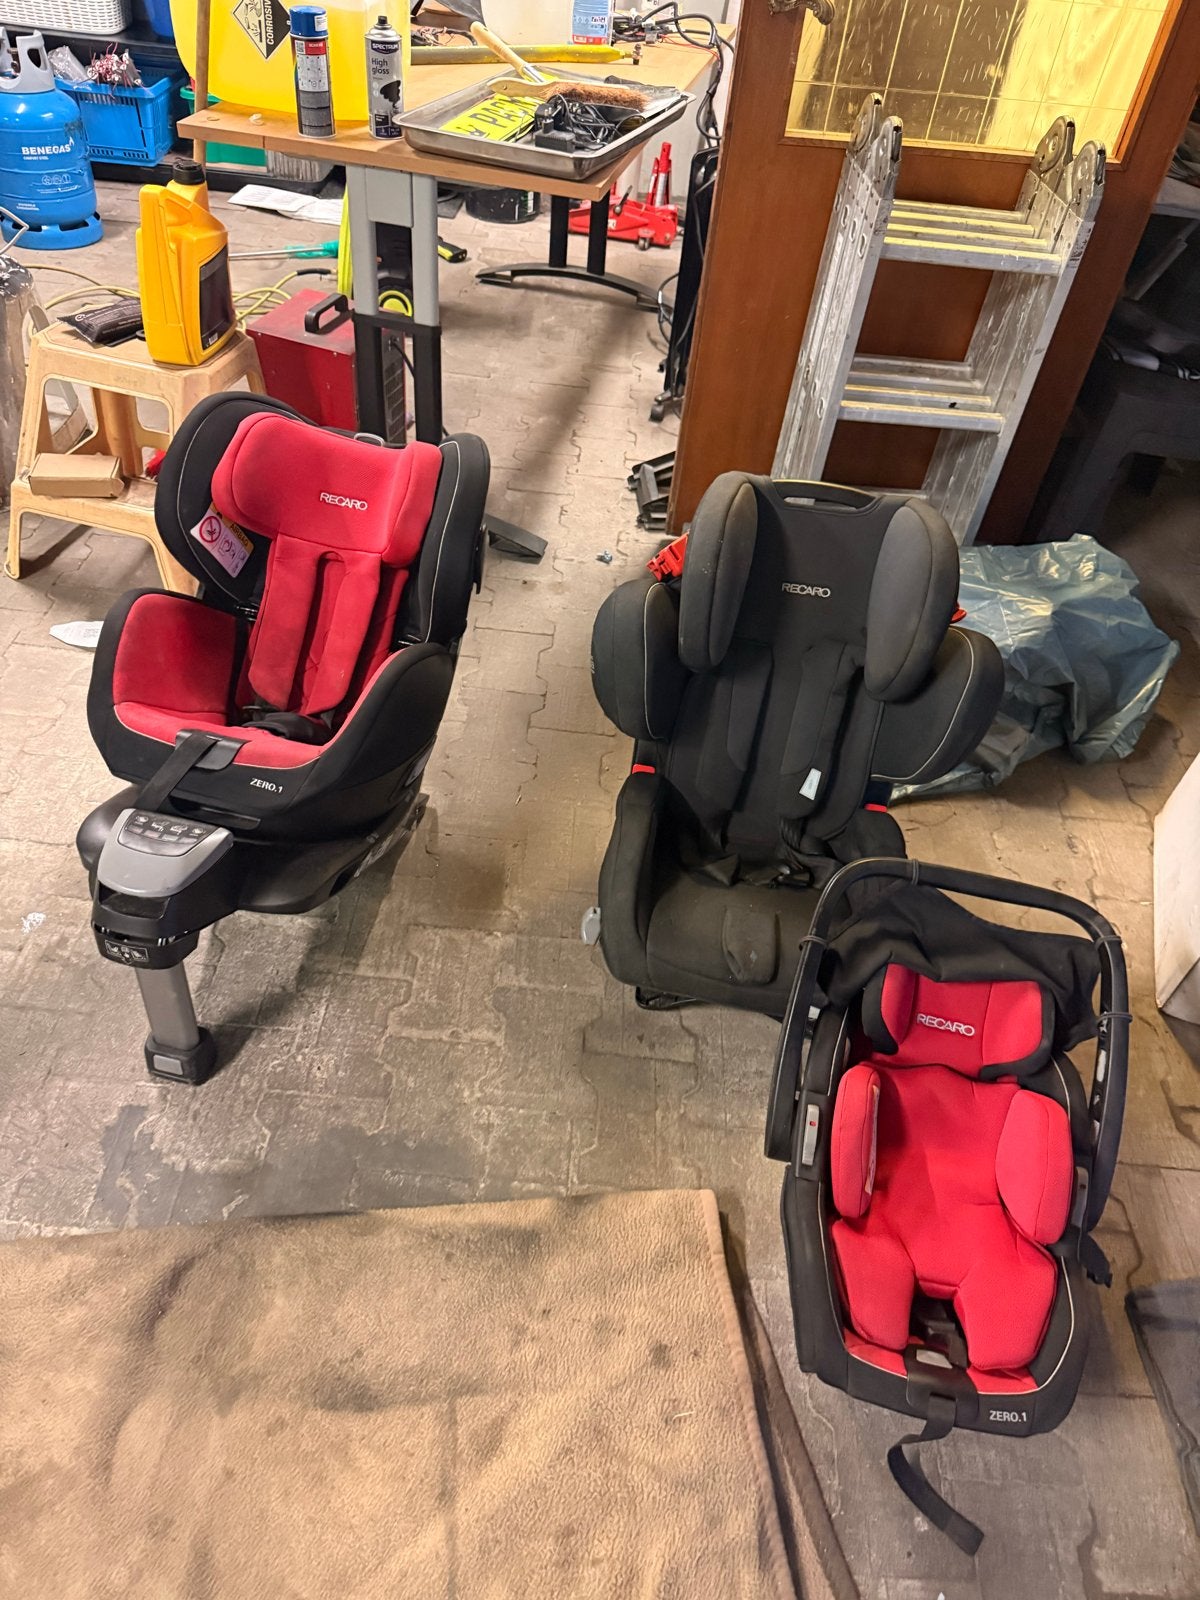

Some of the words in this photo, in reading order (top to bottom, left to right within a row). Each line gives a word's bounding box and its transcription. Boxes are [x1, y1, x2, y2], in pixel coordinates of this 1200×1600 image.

[371, 58, 388, 68] High
[372, 66, 390, 75] gloss
[22, 144, 71, 155] BENEGAS
[320, 492, 368, 511] RECARO
[782, 582, 831, 598] RECARO
[250, 777, 283, 793] ZERO.1
[917, 1013, 975, 1037] RECARO
[989, 1410, 1027, 1422] ZERO.1
